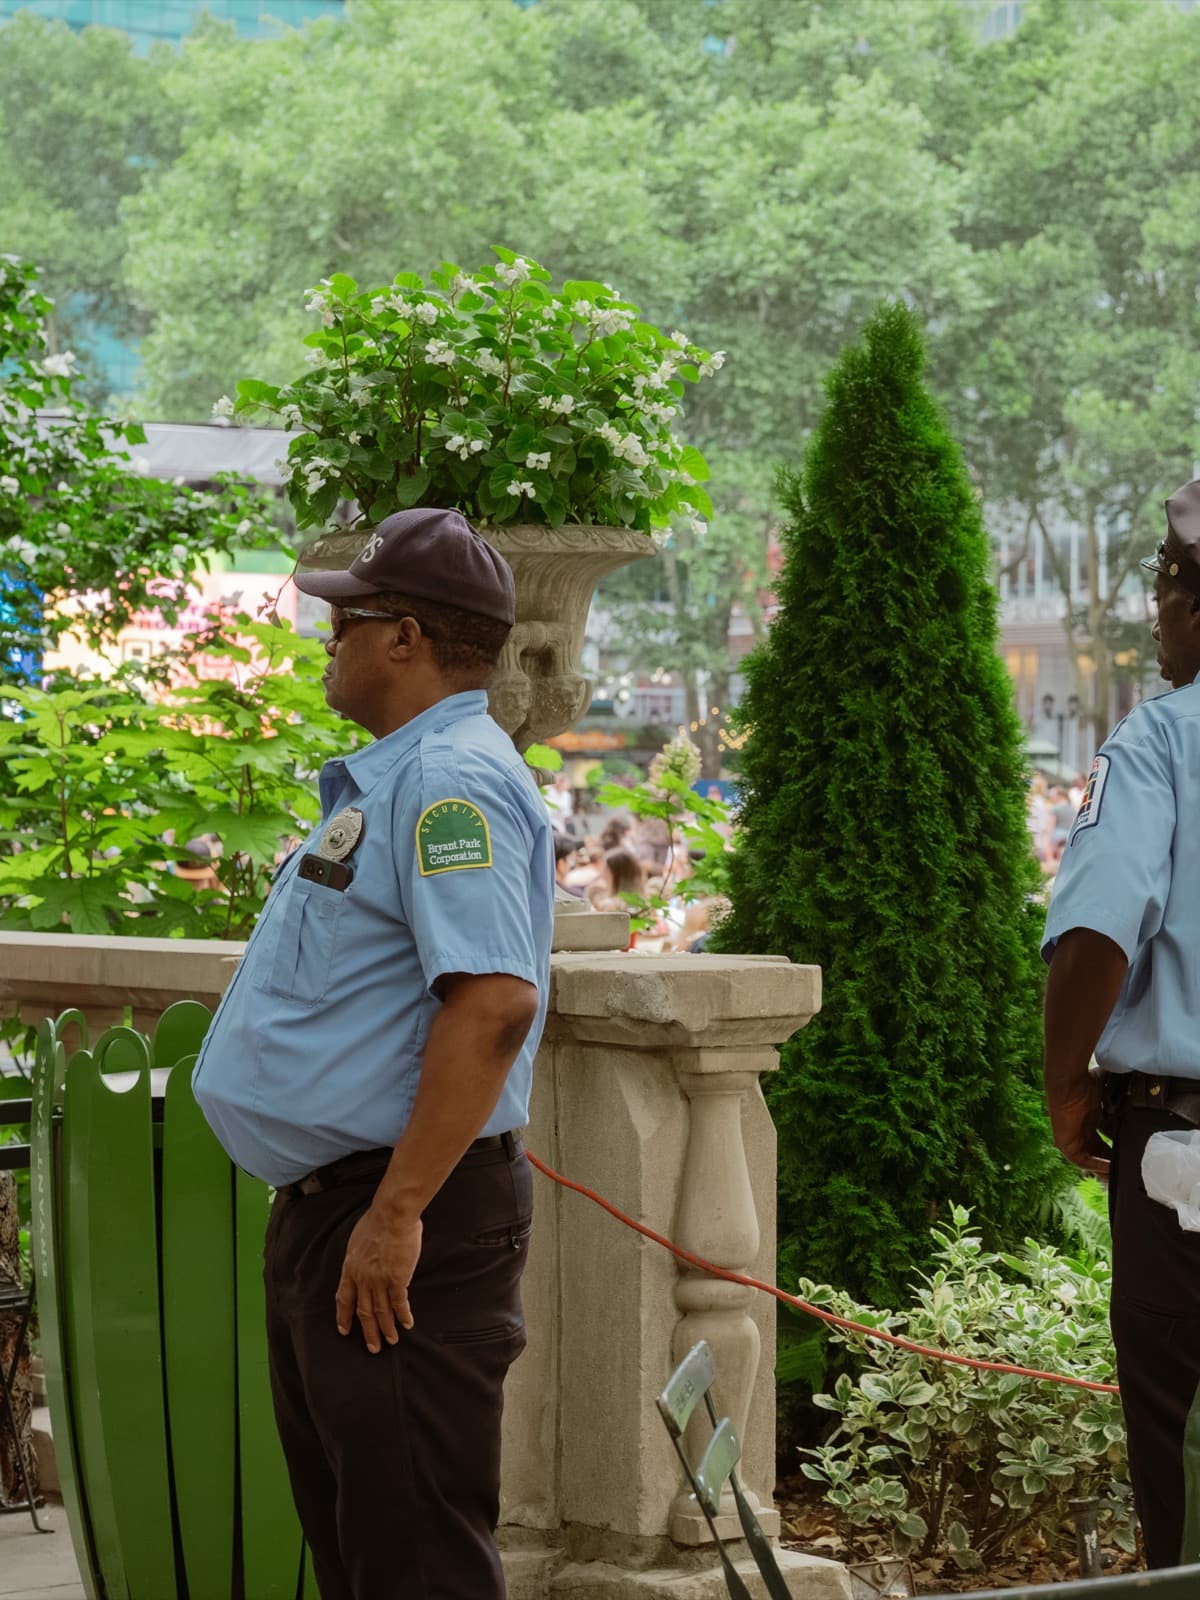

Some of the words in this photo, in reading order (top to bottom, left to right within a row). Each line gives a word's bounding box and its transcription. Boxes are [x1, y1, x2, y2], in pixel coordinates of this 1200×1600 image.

[421, 804, 483, 833] SECURITY
[427, 841, 458, 855] Bryant
[459, 838, 481, 850] Park
[429, 851, 482, 865] Corporation
